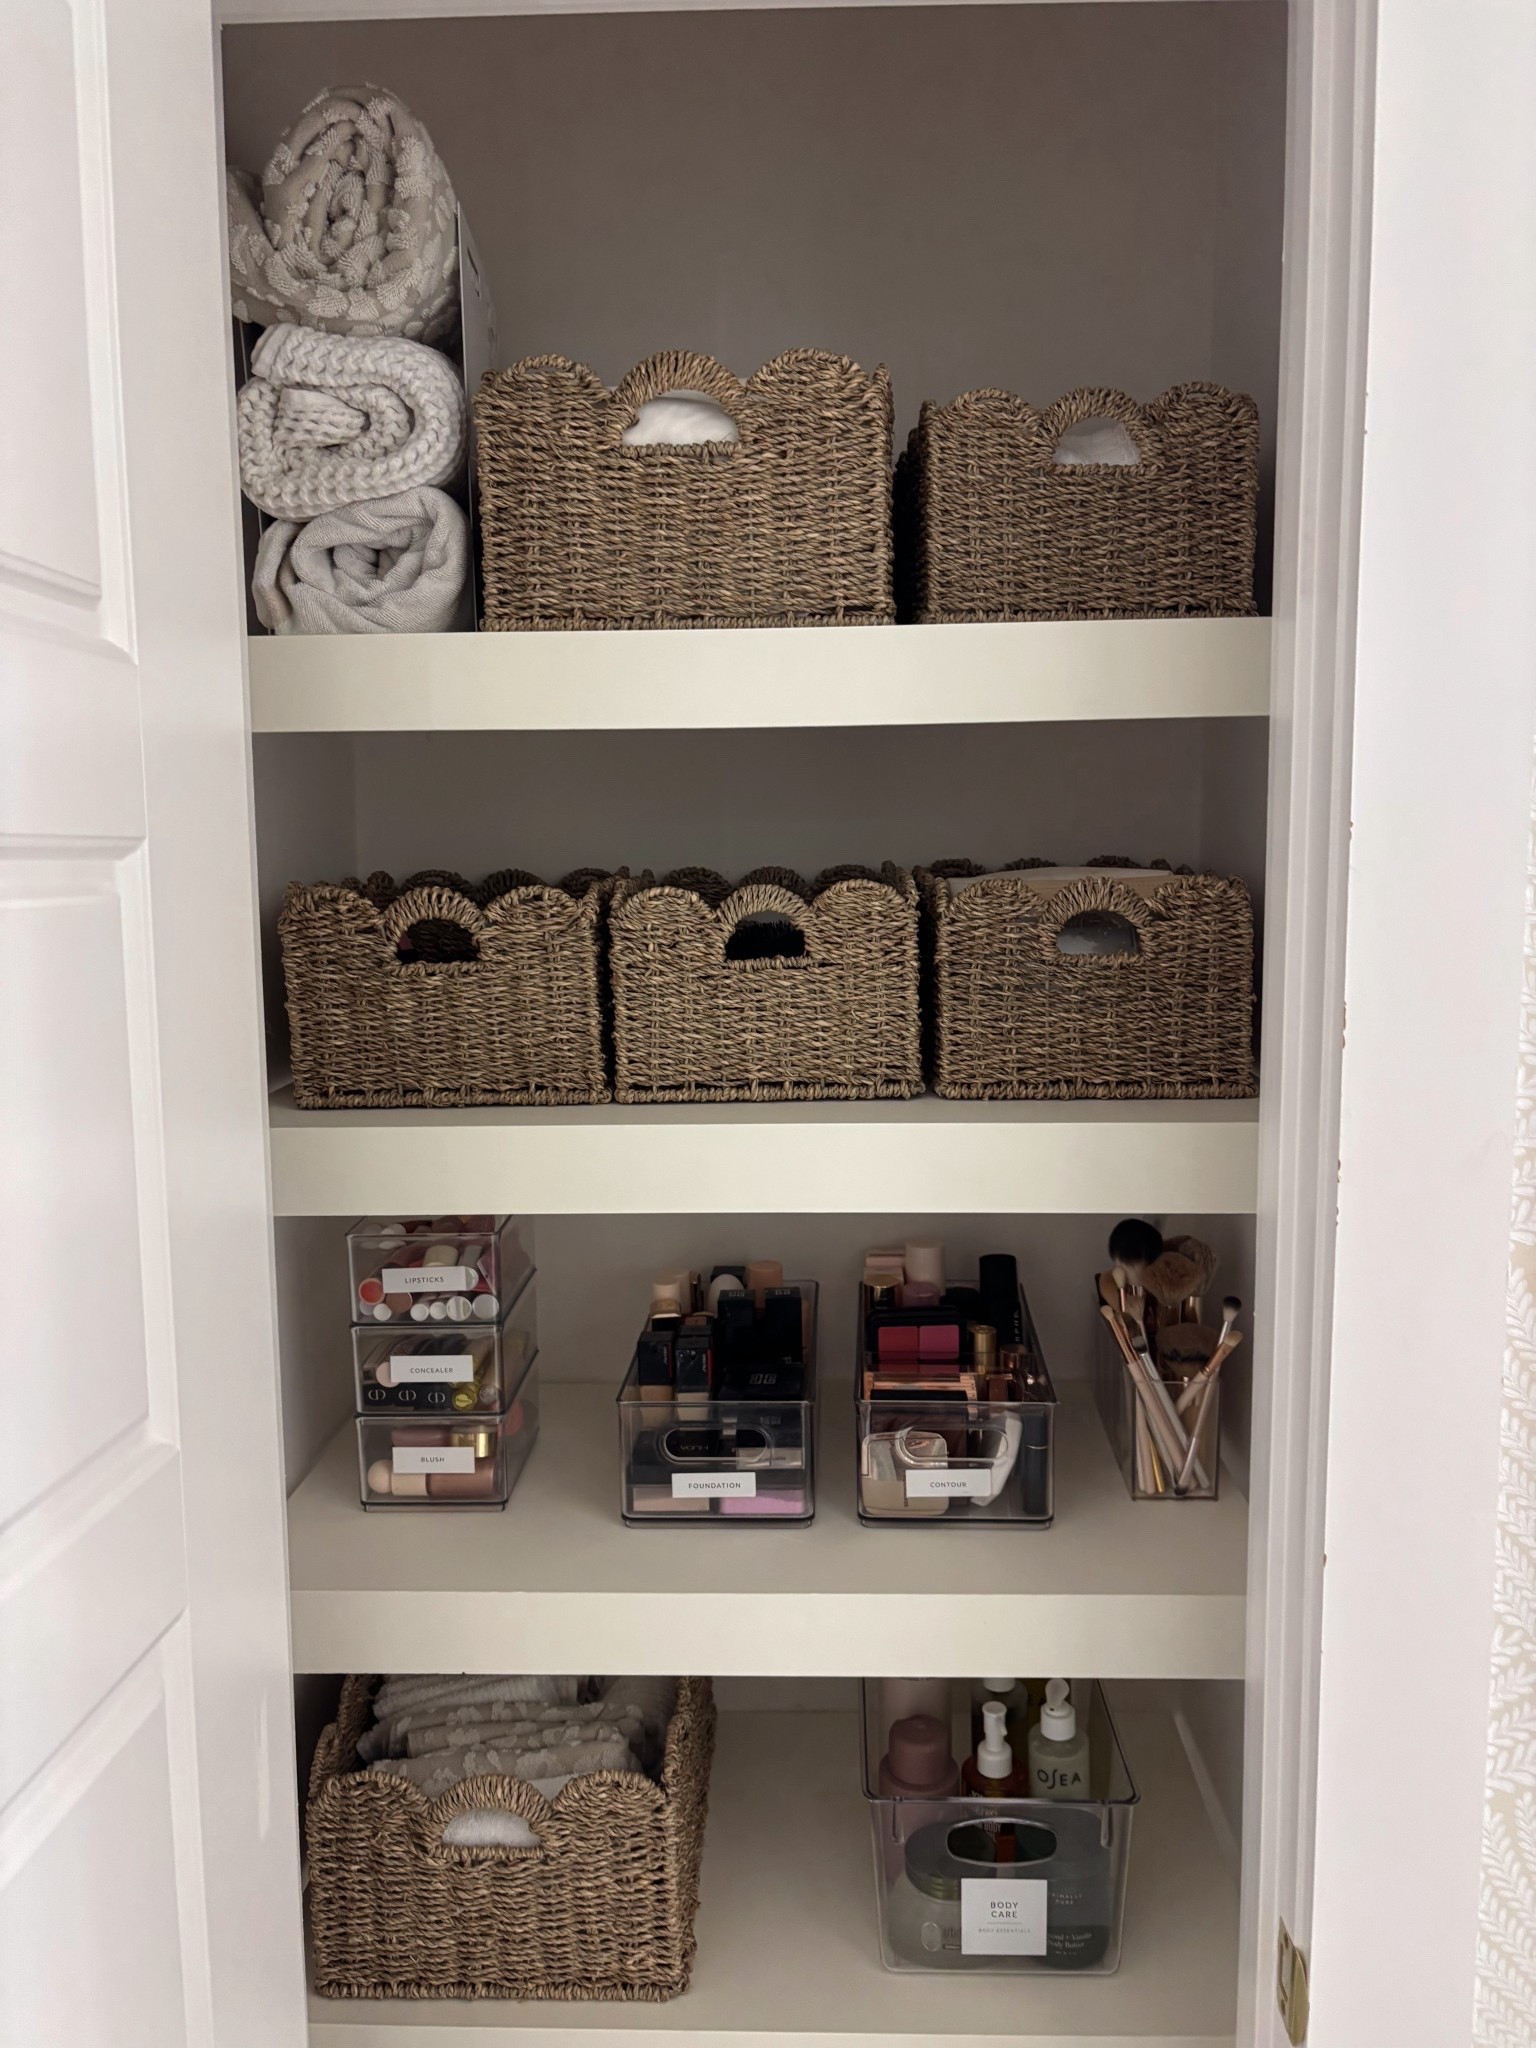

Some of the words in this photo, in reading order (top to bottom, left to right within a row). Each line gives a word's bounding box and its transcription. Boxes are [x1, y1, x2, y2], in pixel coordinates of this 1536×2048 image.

[404, 1276, 445, 1284] LIPSTICKS
[1037, 1768, 1082, 1790] OSEA
[990, 1901, 1019, 1909] BODY
[991, 1911, 1018, 1919] CARE
